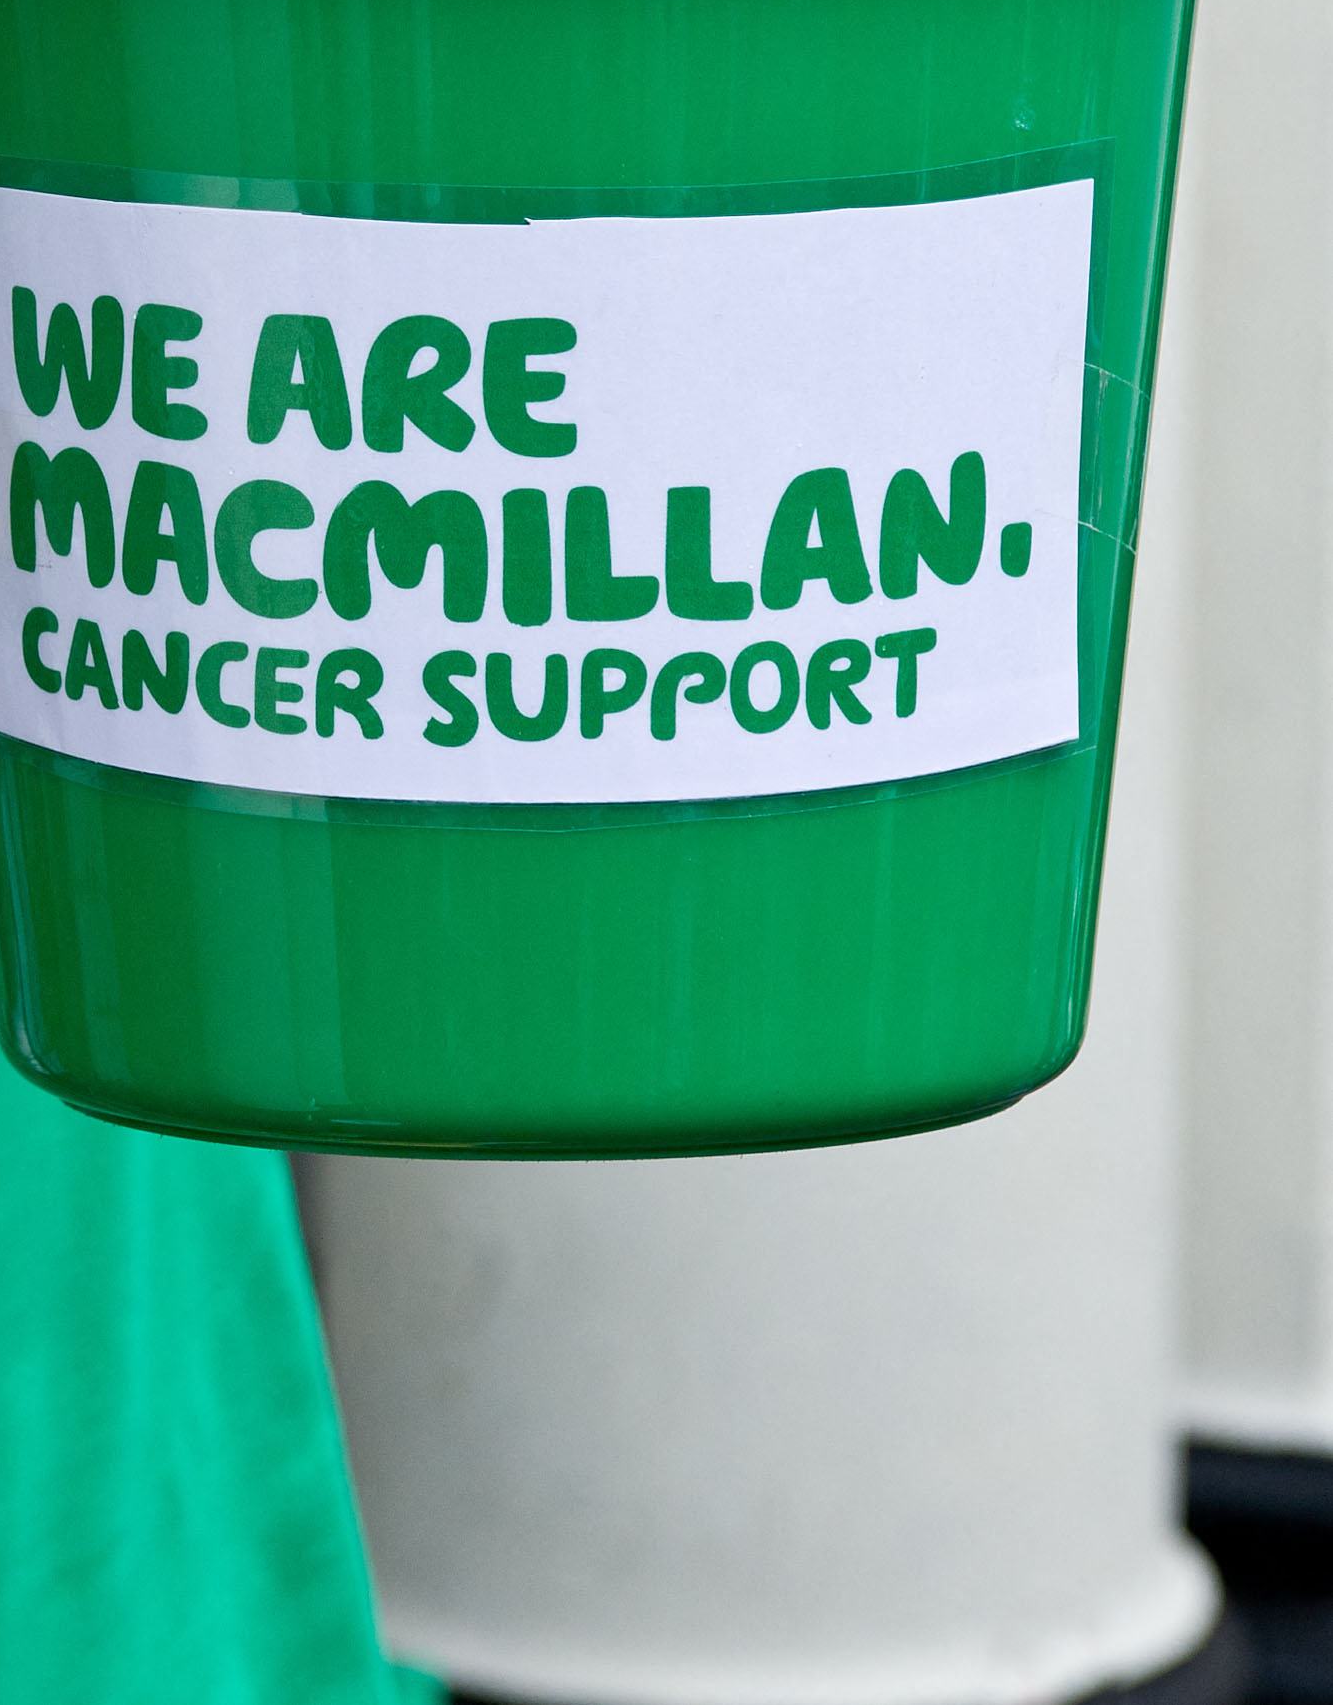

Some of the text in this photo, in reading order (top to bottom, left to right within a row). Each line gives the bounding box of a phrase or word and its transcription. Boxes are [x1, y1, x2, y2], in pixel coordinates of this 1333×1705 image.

[11, 284, 578, 460] WE ARE
[8, 438, 1033, 629] MACMILLAN.
[21, 604, 939, 749] CANCER SUPPORT
